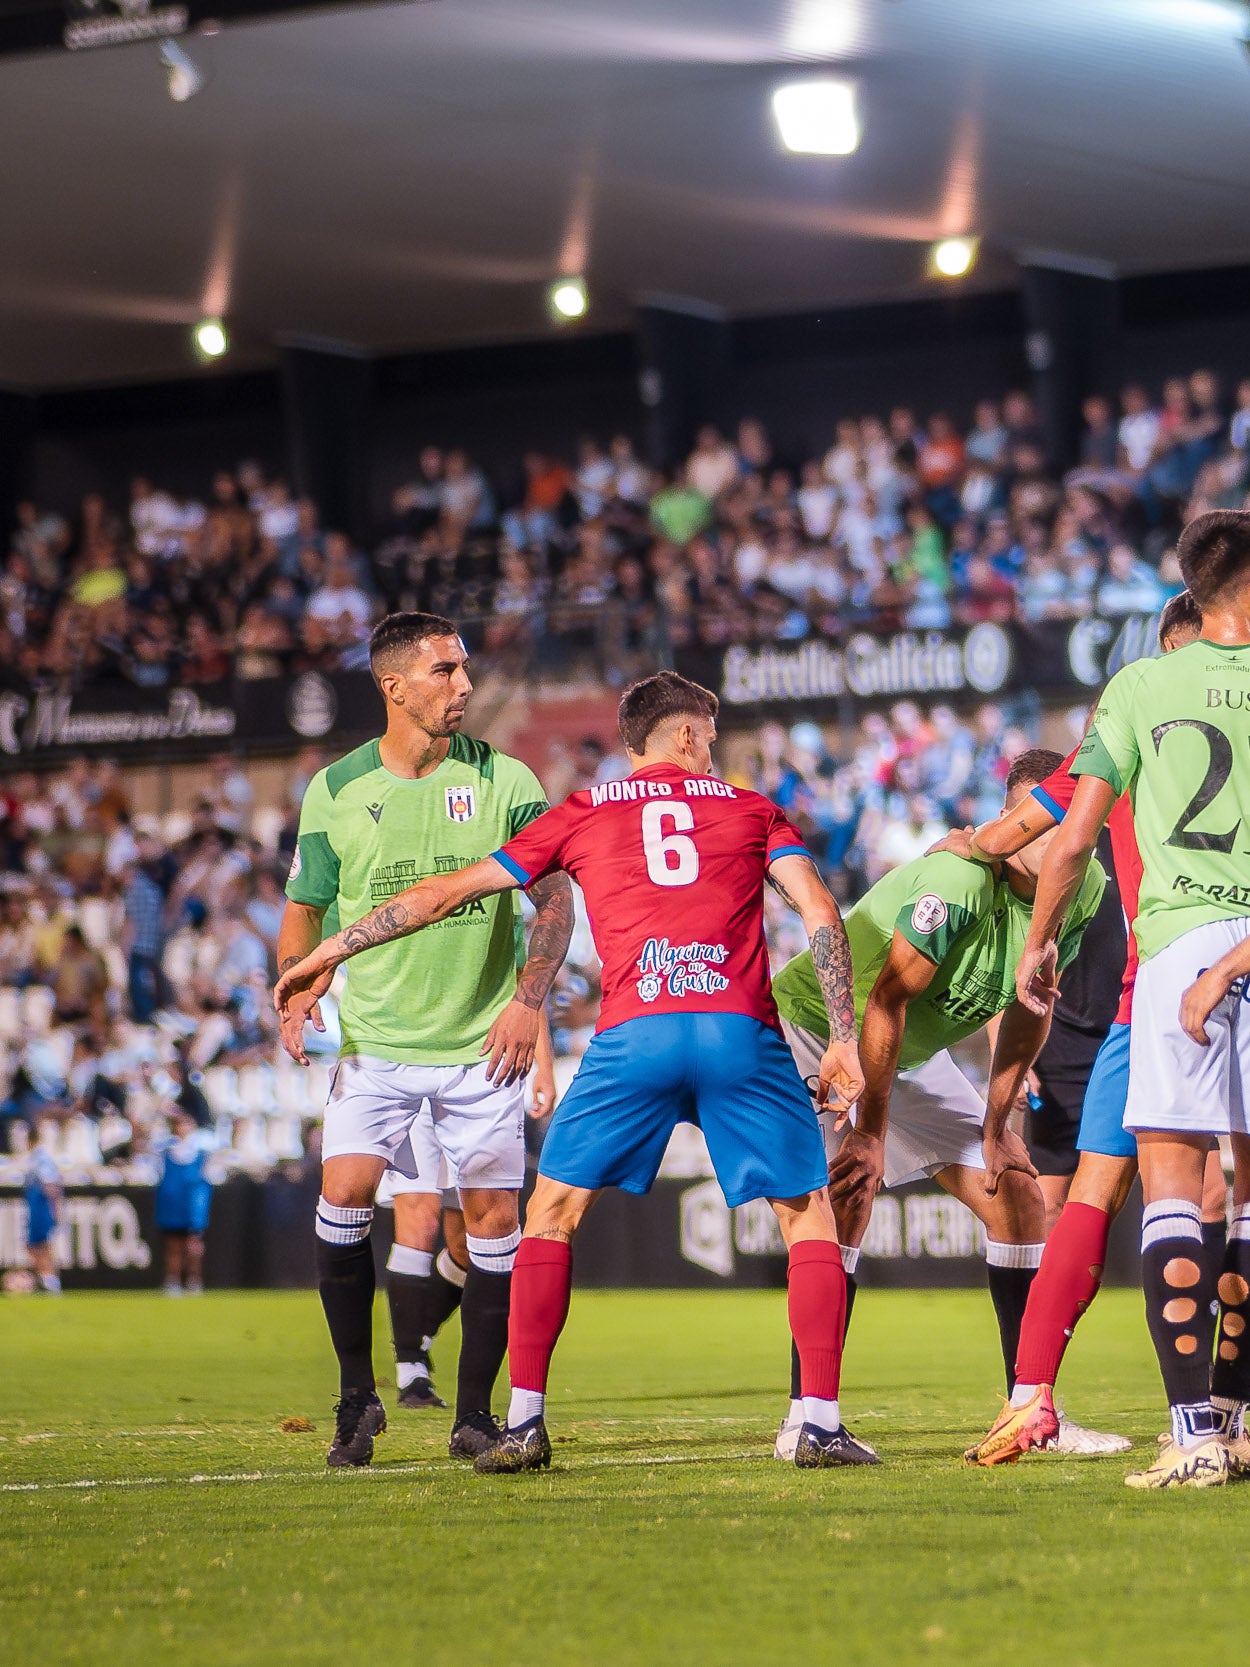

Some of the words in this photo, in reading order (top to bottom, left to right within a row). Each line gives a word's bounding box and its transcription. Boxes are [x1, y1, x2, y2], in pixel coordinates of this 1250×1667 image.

[642, 800, 700, 886] 6
[444, 916, 490, 929] HUMANIDAD
[637, 938, 730, 974] Algeciras
[668, 964, 730, 997] Gusta
